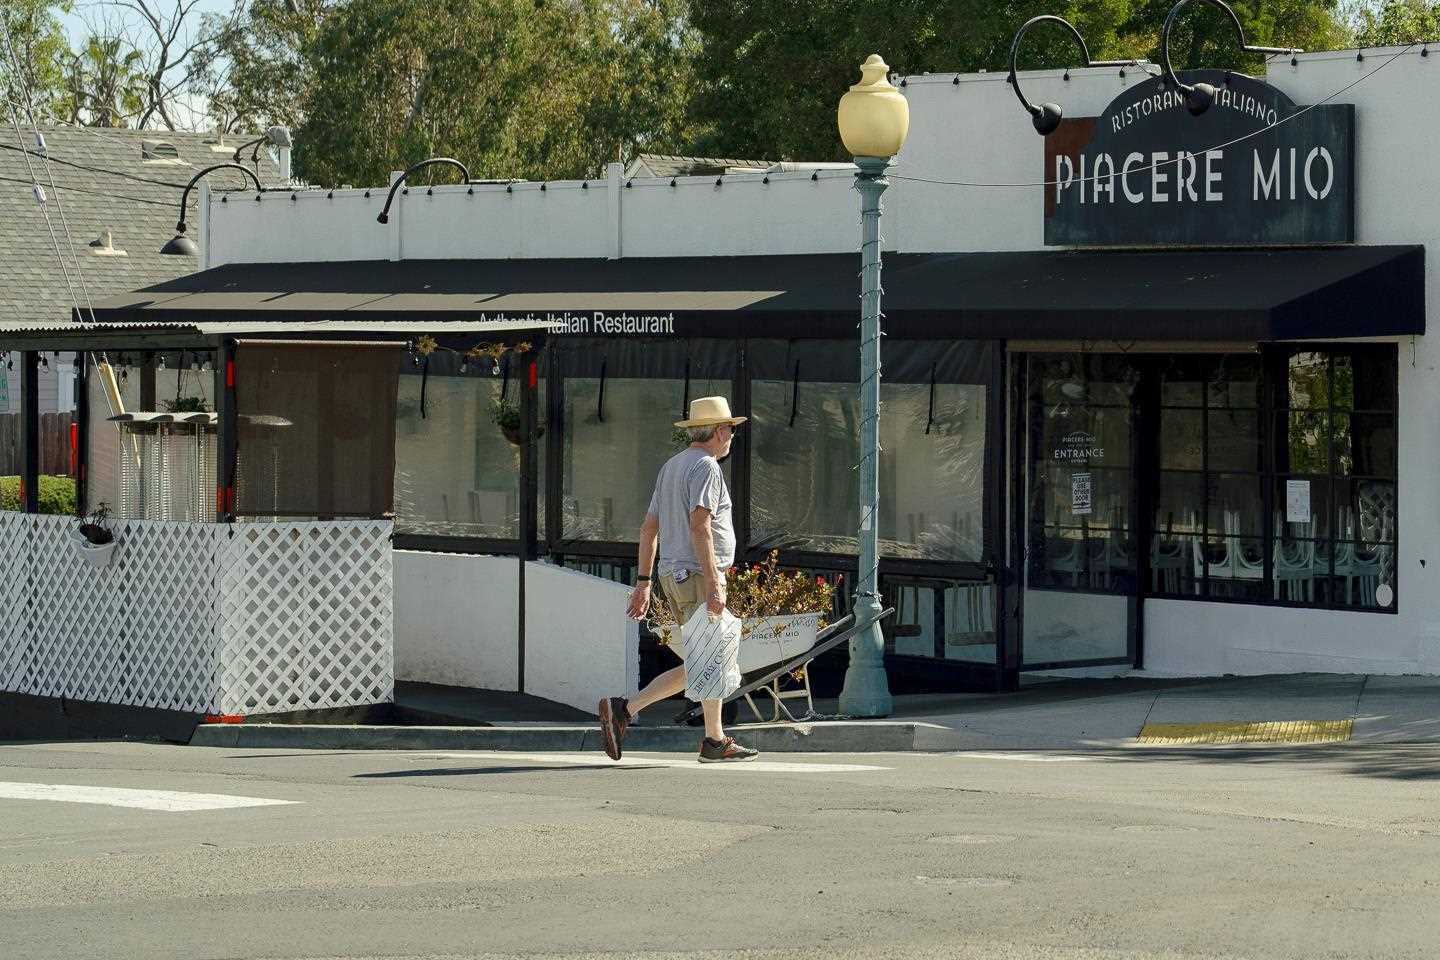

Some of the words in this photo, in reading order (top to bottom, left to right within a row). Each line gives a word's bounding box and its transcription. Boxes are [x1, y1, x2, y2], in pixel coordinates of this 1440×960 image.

[1111, 90, 1185, 134] RISTORAN
[1212, 88, 1278, 127] TALIANO
[1055, 150, 1223, 204] PIACERE
[1252, 146, 1334, 201] MIO
[593, 311, 675, 334] Restaurant
[1054, 448, 1105, 459] ENTRANCE
